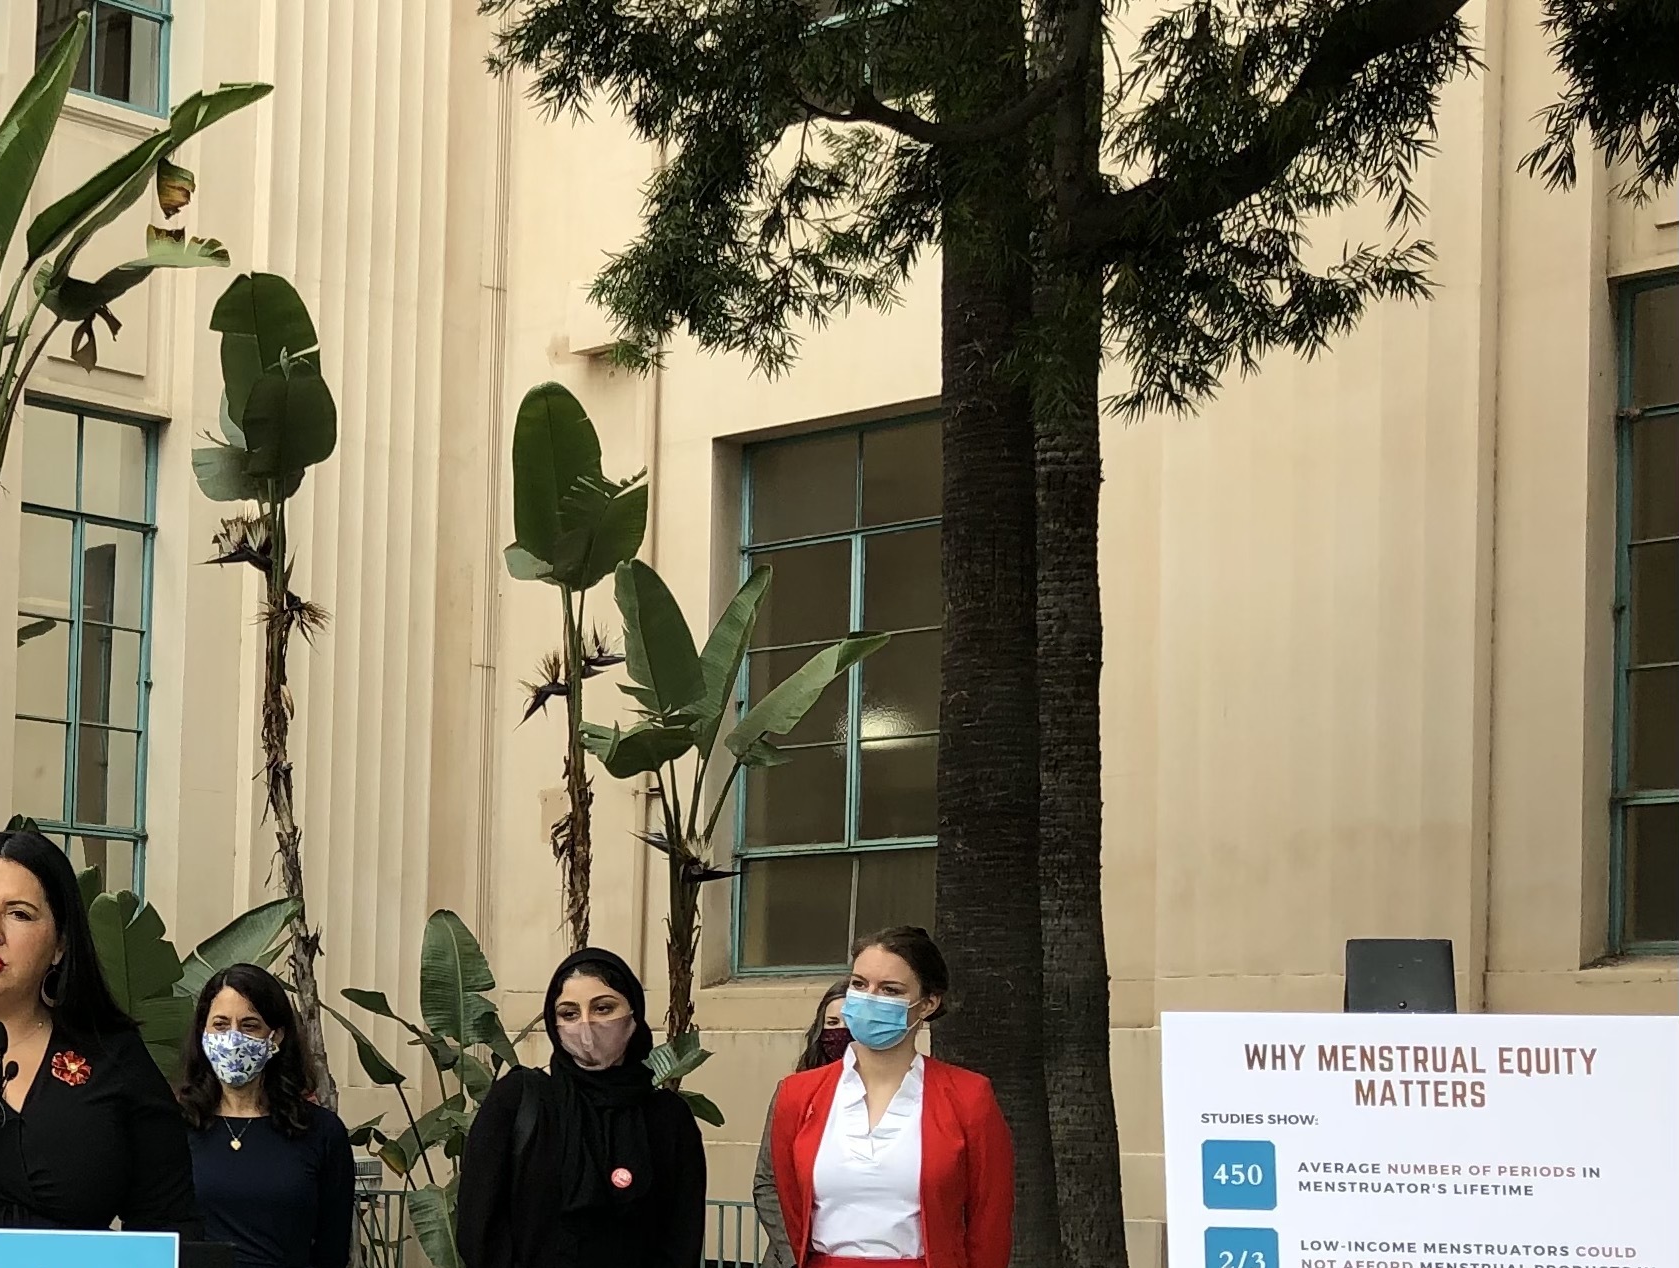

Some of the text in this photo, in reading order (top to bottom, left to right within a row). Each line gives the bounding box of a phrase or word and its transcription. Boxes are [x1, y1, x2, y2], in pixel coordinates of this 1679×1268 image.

[1244, 1043, 1598, 1078] WHY MENSTRUAL EQUITY
[1354, 1079, 1486, 1108] MATTERS
[1200, 1113, 1320, 1127] STUDIES SHOW:
[1212, 1162, 1264, 1187] 450
[1297, 1161, 1601, 1179] AVERAGE NUMBER OF PERIODS IN
[1297, 1180, 1534, 1197] MENSTRUATOR'S LIFETIME
[1300, 1238, 1638, 1259] LOW-INCOME MENSTRUATORS COULD
